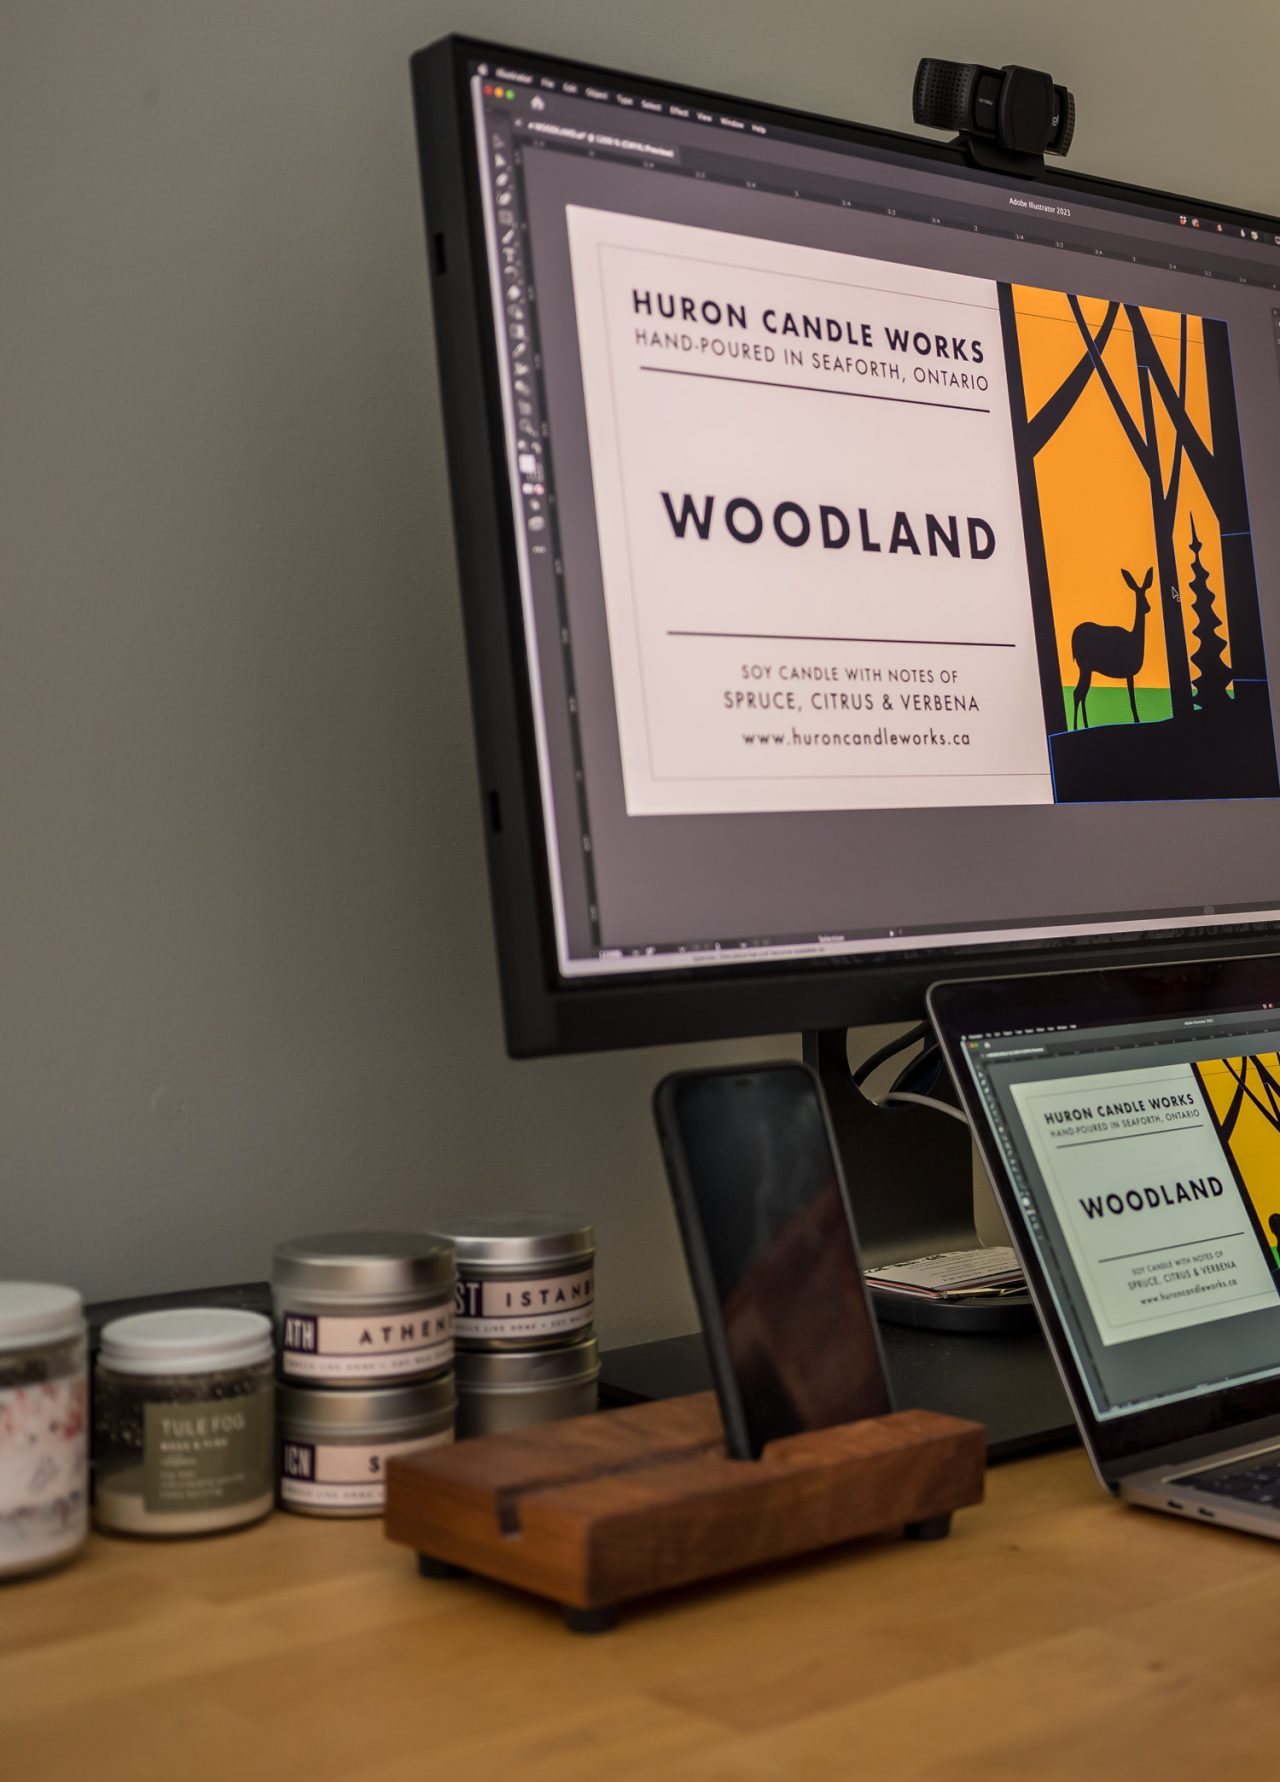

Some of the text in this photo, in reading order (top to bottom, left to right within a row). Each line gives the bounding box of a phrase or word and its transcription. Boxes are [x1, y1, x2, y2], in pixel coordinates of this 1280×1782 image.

[1009, 197, 1071, 217] Adobe Illustrator 2023
[632, 289, 984, 364] HURON CANDLE WORKS
[635, 327, 989, 392] HAND-POURED IN SEAFORTH, ONTARIO
[660, 490, 996, 560] WOODLAND
[741, 664, 959, 684] SOY CANDLE WITH NOTES OF
[723, 691, 980, 713] SPRUCE, CITRUS & VERBENA
[741, 727, 971, 746] www.huroncandleworks.ca
[1044, 1093, 1195, 1125] HURON CANDLE WORKS
[1050, 1109, 1200, 1138] HAND-POURED IN SEAFORTH, ONTARIO
[1079, 1176, 1224, 1219] WOODLAND
[1127, 1261, 1237, 1290] SPRUCE, CITRUS & VERBENA
[1146, 1261, 1173, 1273] CANDLE
[1175, 1257, 1191, 1267] WITH
[1192, 1252, 1213, 1263] NOTES
[1214, 1250, 1224, 1258] OF
[1140, 1278, 1238, 1305] www.huroncandleworks.ca
[285, 1315, 453, 1350] ATH ATHEN
